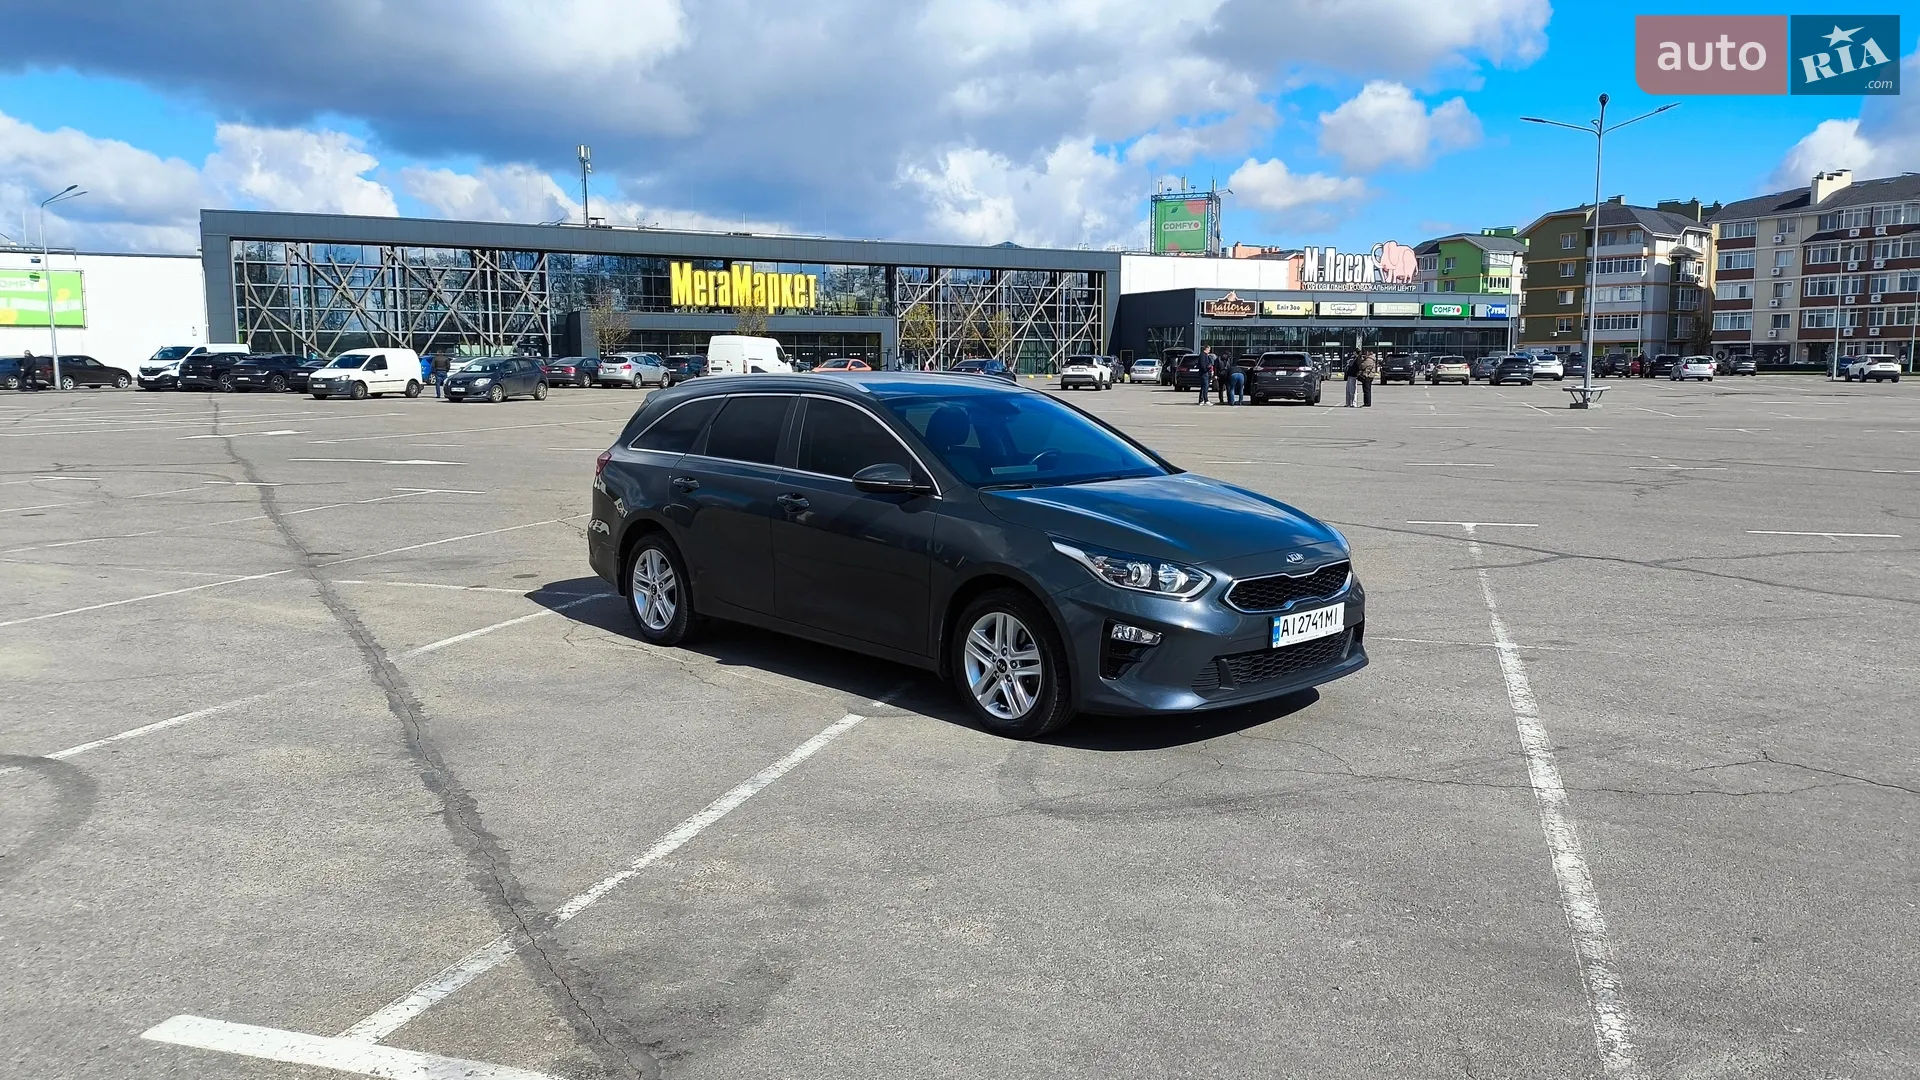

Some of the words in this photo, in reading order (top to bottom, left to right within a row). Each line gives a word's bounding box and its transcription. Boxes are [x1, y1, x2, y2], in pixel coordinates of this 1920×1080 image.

[670, 261, 817, 315] МегаМаркет
[1210, 302, 1252, 312] Trattoria
[1287, 552, 1303, 562] KIA
